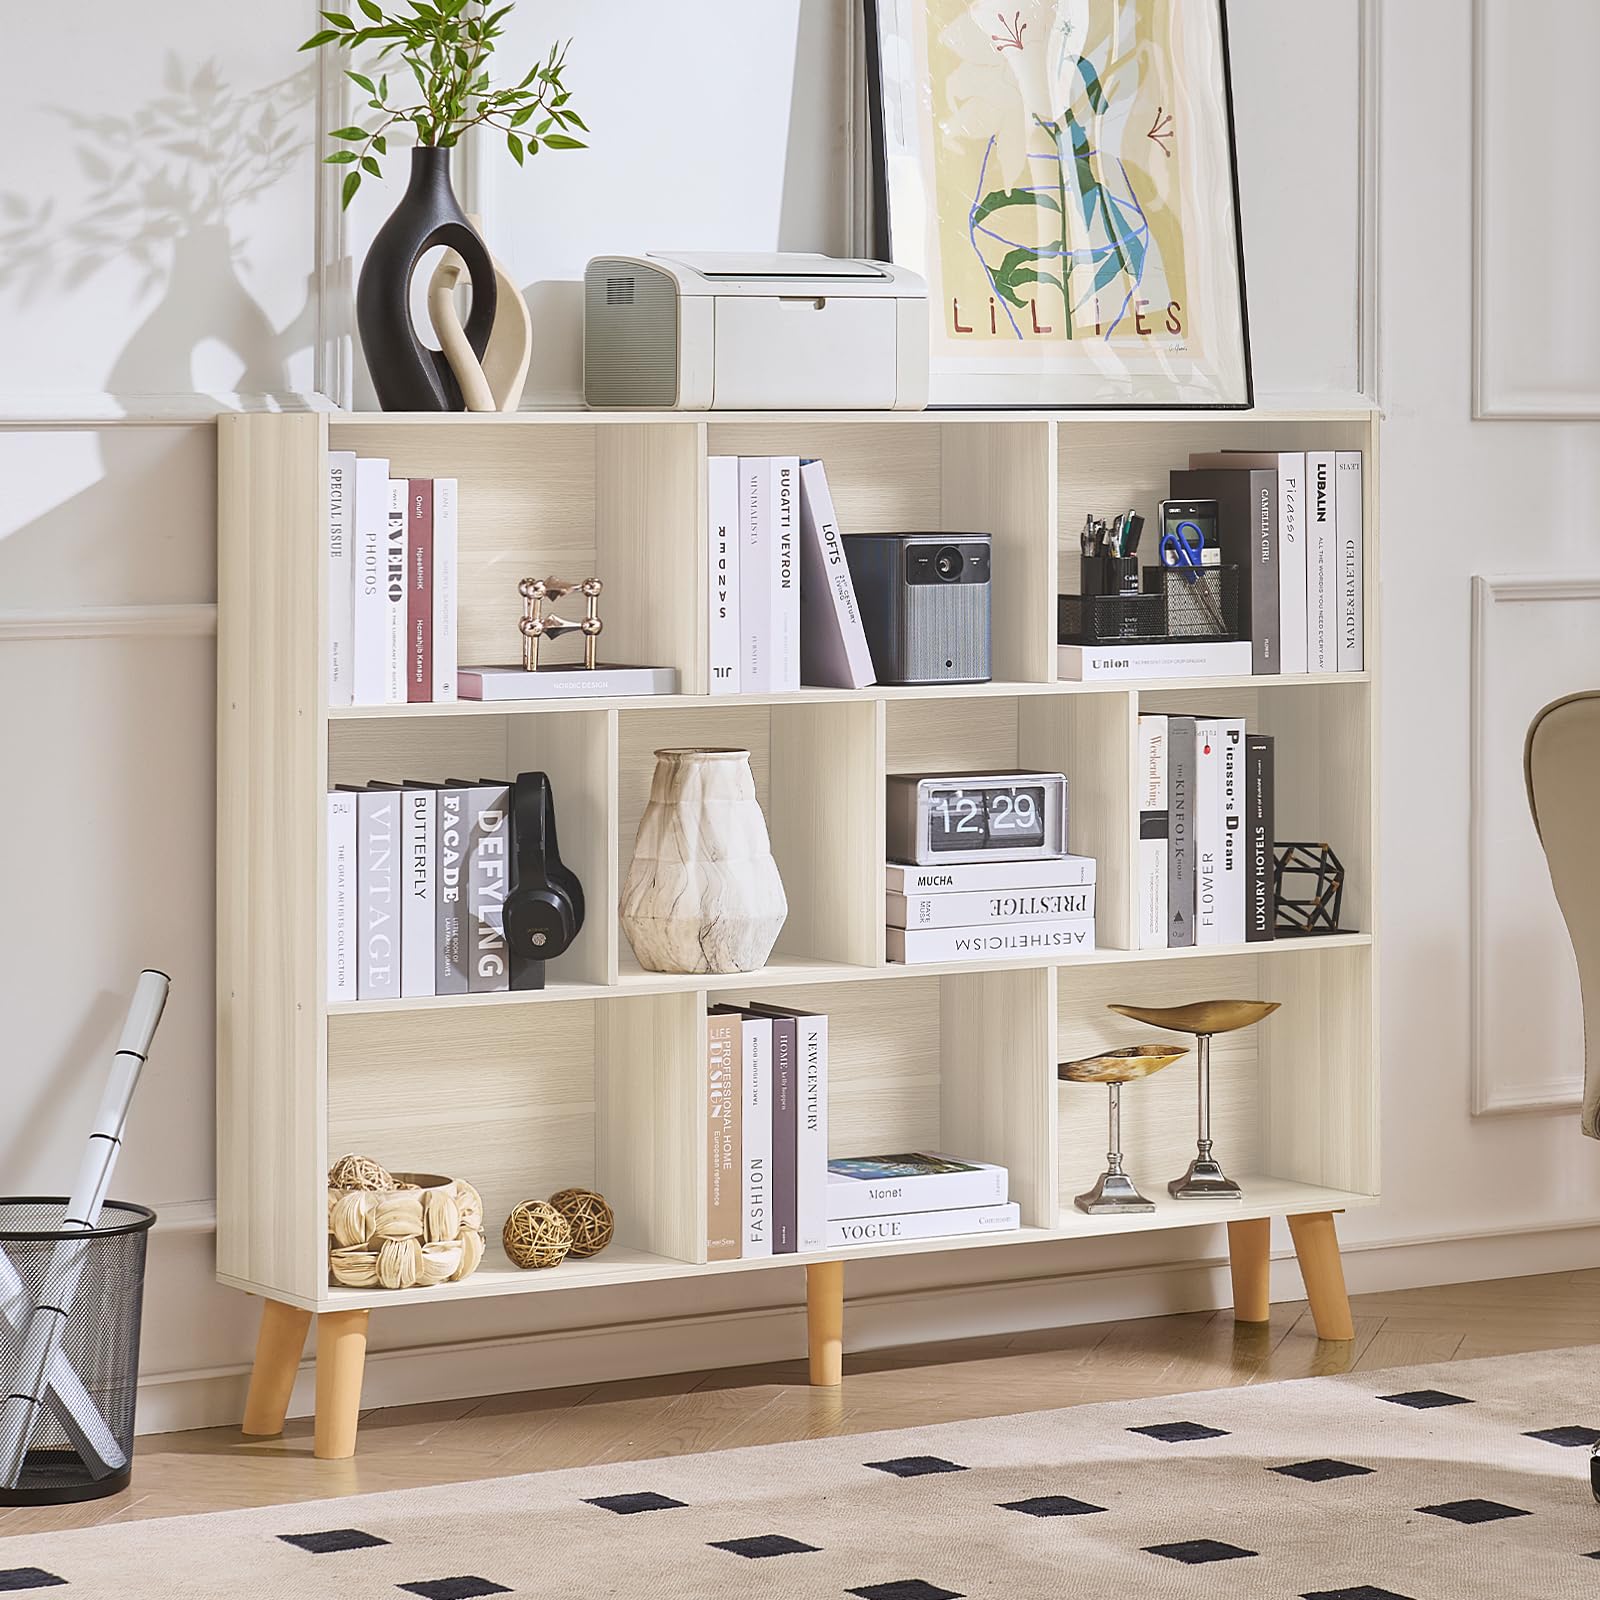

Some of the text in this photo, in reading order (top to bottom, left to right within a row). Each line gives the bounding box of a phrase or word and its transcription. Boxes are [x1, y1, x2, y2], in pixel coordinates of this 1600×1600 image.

[330, 467, 343, 559] SPECIAL ISSUE
[750, 474, 759, 546] MINIMALISTA
[1260, 488, 1270, 563] CAMELLIA GIRL
[1286, 478, 1297, 543] Picasso
[1316, 463, 1327, 523] LUBALIN
[781, 468, 791, 589] BUGATTI VEYRON
[822, 523, 842, 566] LOFTS
[364, 532, 377, 597] PHOTOS
[844, 589, 857, 625] CENTURY
[1093, 658, 1130, 670] Union
[1145, 735, 1161, 807] Weekend living
[1225, 729, 1240, 872] Picasso's Dream
[992, 794, 1037, 829] 29
[1175, 779, 1185, 858] KINFOLK
[337, 844, 345, 862] THE
[414, 797, 427, 900] BUTTERFLY
[443, 796, 460, 904] FACADE
[917, 875, 954, 887] MUCHA
[1256, 826, 1267, 931] LUXURY HOTELS
[337, 890, 345, 929] ARTISTS
[368, 803, 392, 988] VINTAGE
[990, 895, 1088, 917] PRESTIGE
[1202, 852, 1214, 926] FLOWER
[337, 929, 345, 987] COLLECTION
[955, 931, 1088, 952] AESTHETICISM
[709, 1028, 732, 1039] LIFE
[710, 1040, 723, 1118] DESIGN
[722, 1041, 732, 1169] PROFESSIONAL HOME
[713, 1130, 722, 1167] European
[749, 1158, 764, 1243] FASHION
[868, 1187, 902, 1200] Monet
[841, 1222, 902, 1240] VOGUE
